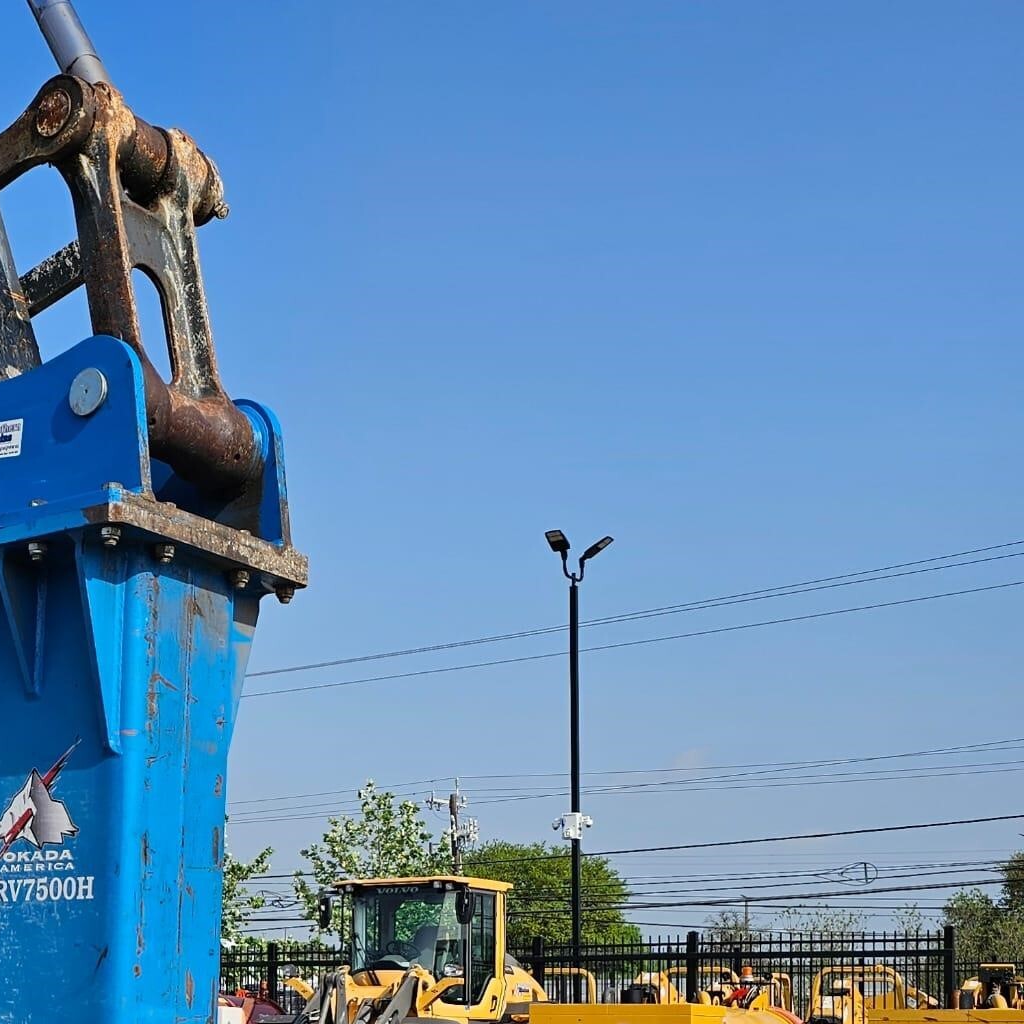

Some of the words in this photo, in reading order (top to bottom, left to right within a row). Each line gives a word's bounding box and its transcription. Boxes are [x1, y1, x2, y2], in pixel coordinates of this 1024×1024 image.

[3, 850, 74, 862] OKADA
[0, 862, 75, 873] AMERICA
[376, 886, 419, 894] VOLVO
